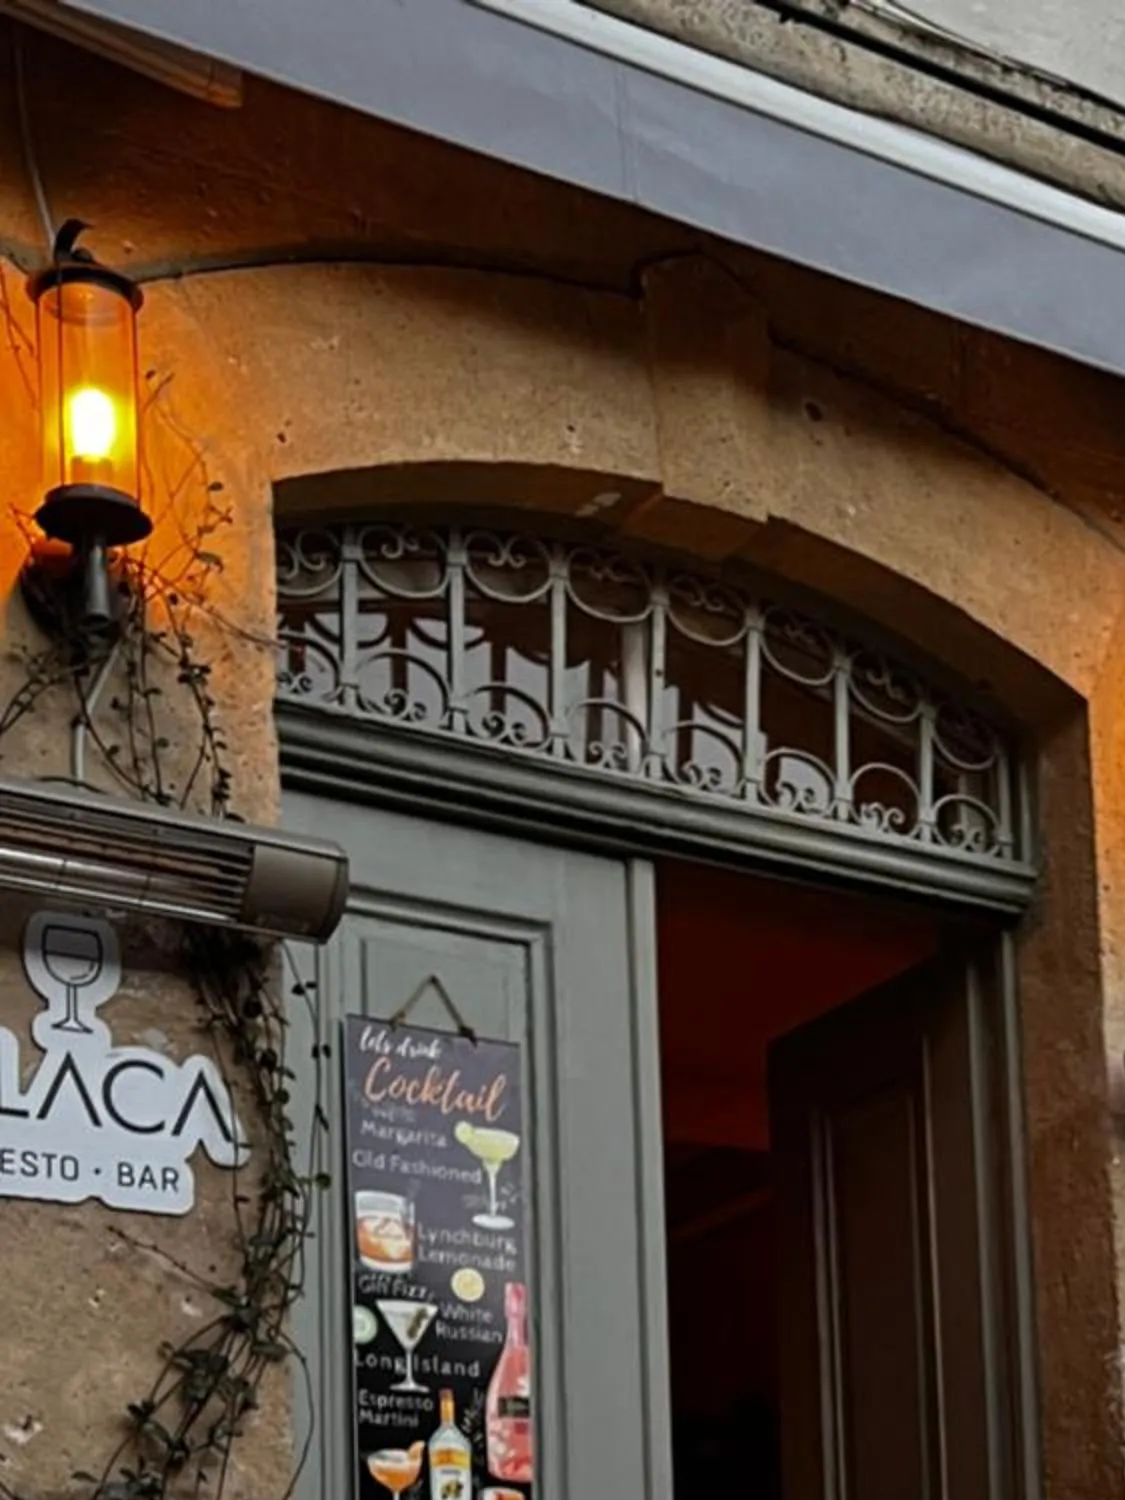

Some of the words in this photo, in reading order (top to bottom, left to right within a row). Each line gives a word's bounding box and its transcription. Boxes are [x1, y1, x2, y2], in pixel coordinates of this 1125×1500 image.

[364, 1056, 506, 1122] Cocktail
[360, 1121, 447, 1147] Margarita
[0, 1149, 79, 1181] ESTO
[117, 1162, 179, 1192] BAR
[352, 1150, 385, 1169] Old
[390, 1157, 482, 1184] Fashioned
[418, 1223, 517, 1255] Lynchburg
[418, 1247, 517, 1272] Lemonade
[393, 1279, 428, 1299] Fizz
[440, 1303, 493, 1323] White
[436, 1320, 502, 1343] Russian
[414, 1353, 480, 1377] Island
[359, 1389, 433, 1410] Espresso
[359, 1409, 418, 1428] Martini
